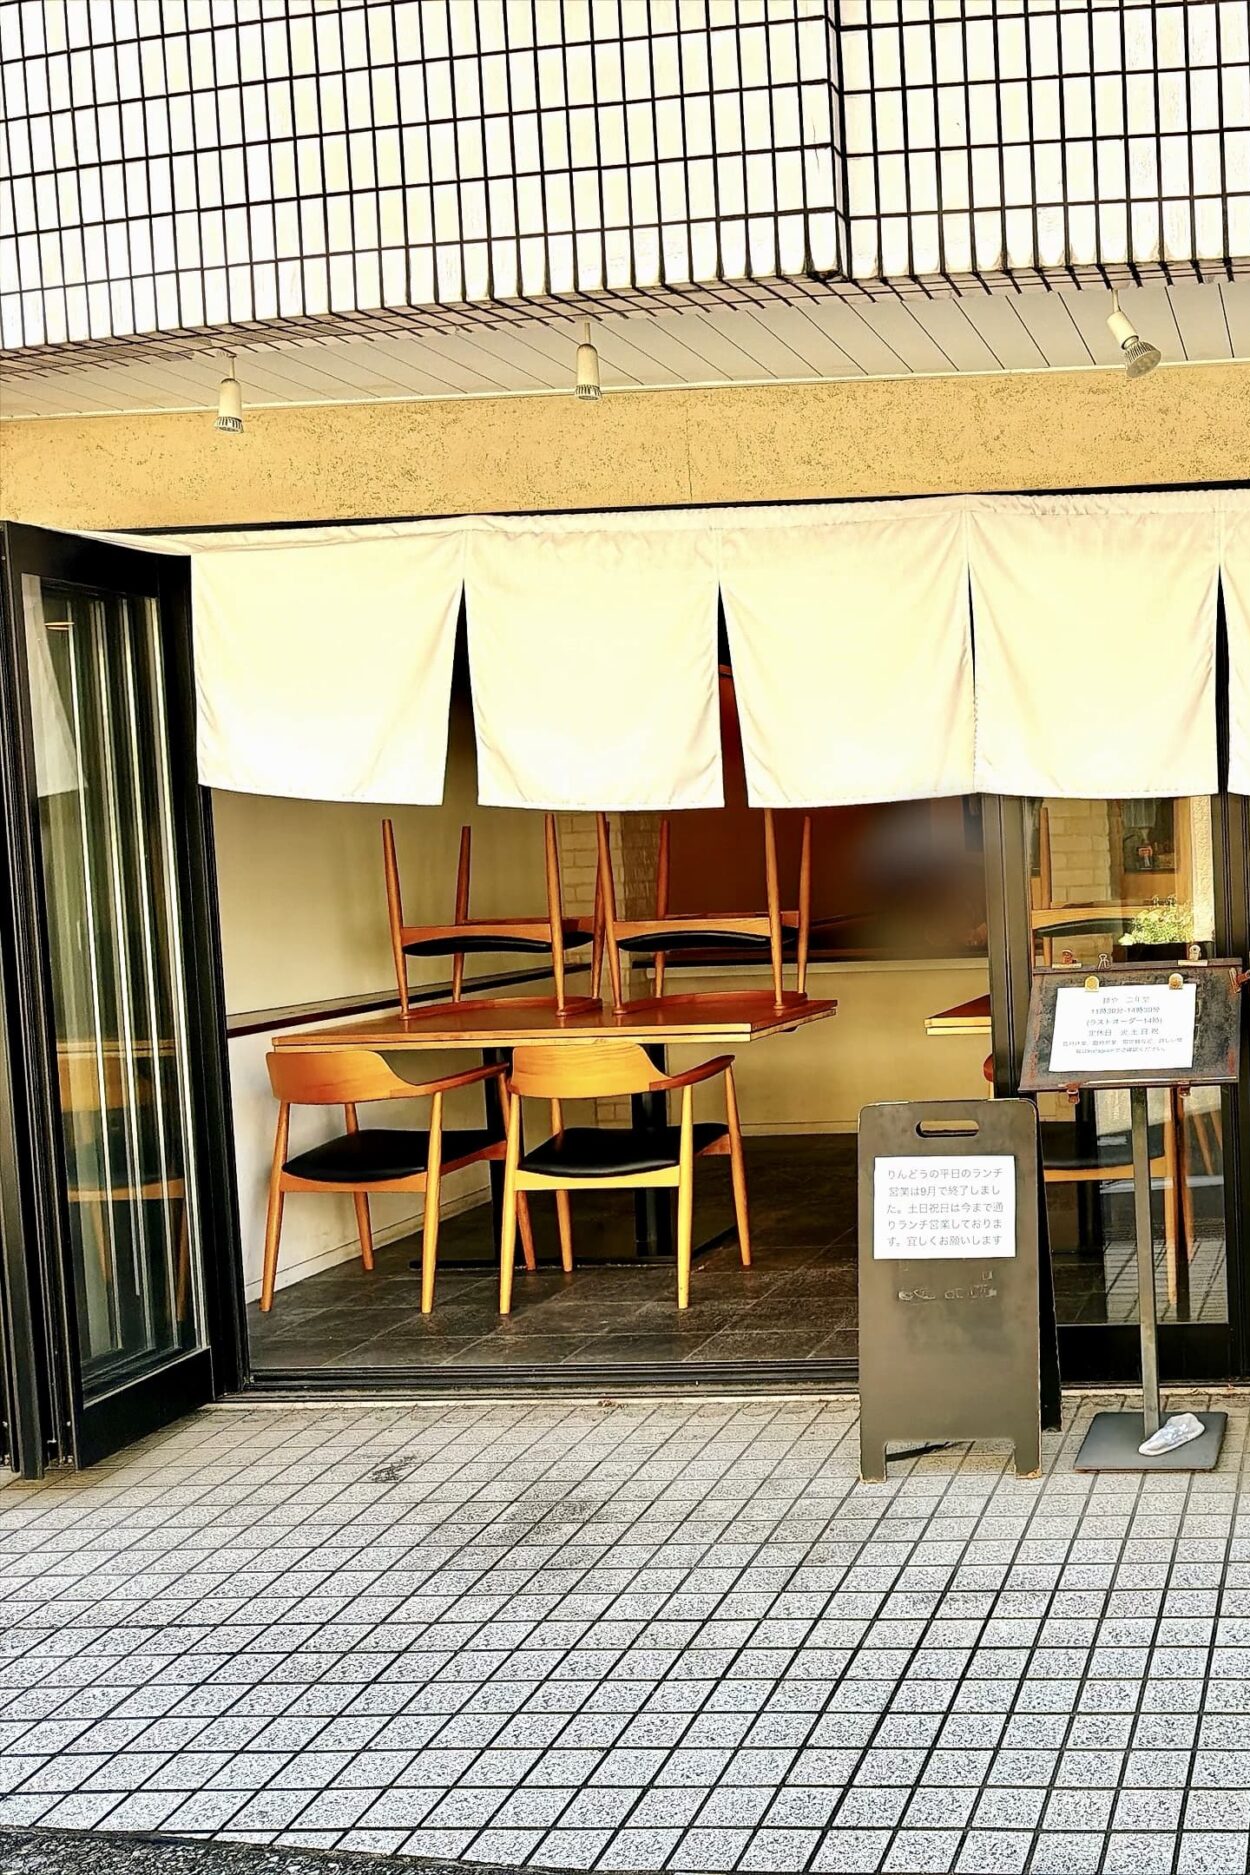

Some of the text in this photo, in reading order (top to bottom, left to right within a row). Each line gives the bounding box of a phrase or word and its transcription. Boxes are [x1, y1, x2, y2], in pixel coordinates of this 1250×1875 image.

[888, 1167, 1003, 1180] りんどうの平日のランチ
[888, 1184, 1001, 1198] 営業は9月で終了しまし
[886, 1201, 1004, 1215] た。土日祝日は今まで通
[888, 1218, 1002, 1231] りランチ営業しておりま
